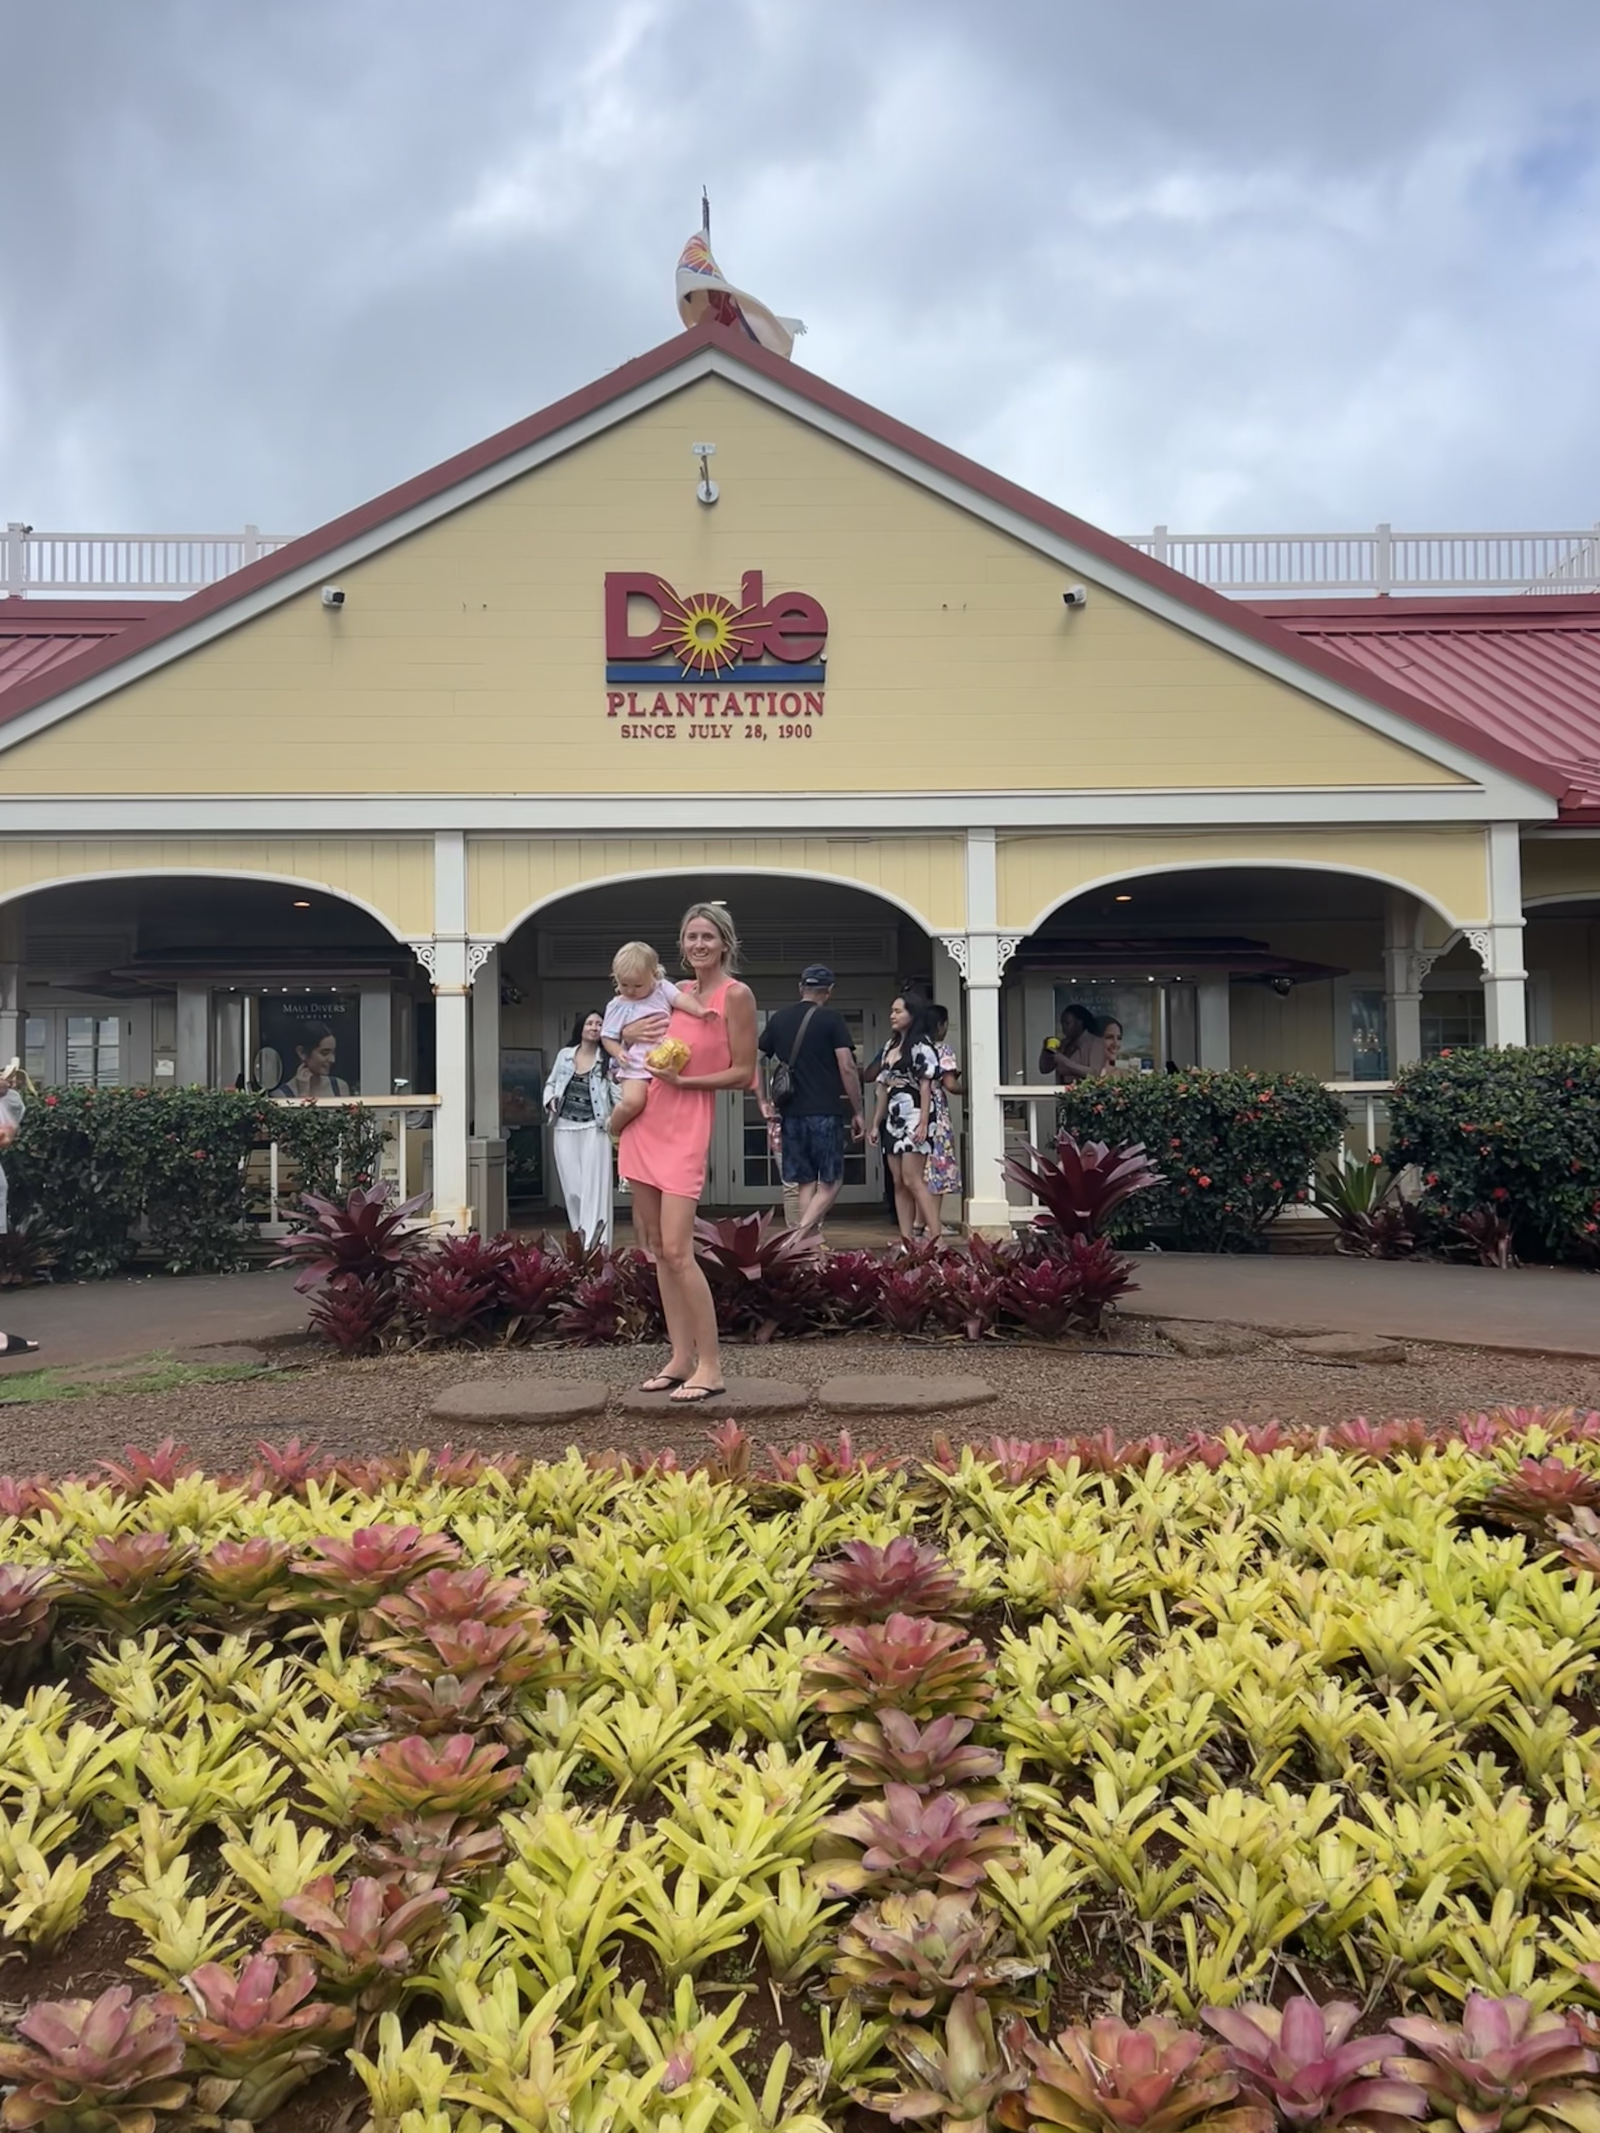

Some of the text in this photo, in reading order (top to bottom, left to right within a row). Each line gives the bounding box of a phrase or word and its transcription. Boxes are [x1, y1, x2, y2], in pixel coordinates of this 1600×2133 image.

[605, 570, 828, 669] Dole
[607, 692, 825, 717] PLANTATION
[621, 724, 812, 741] SINCE JULY 28, 1900
[283, 1003, 346, 1013] MAUI DIVERS
